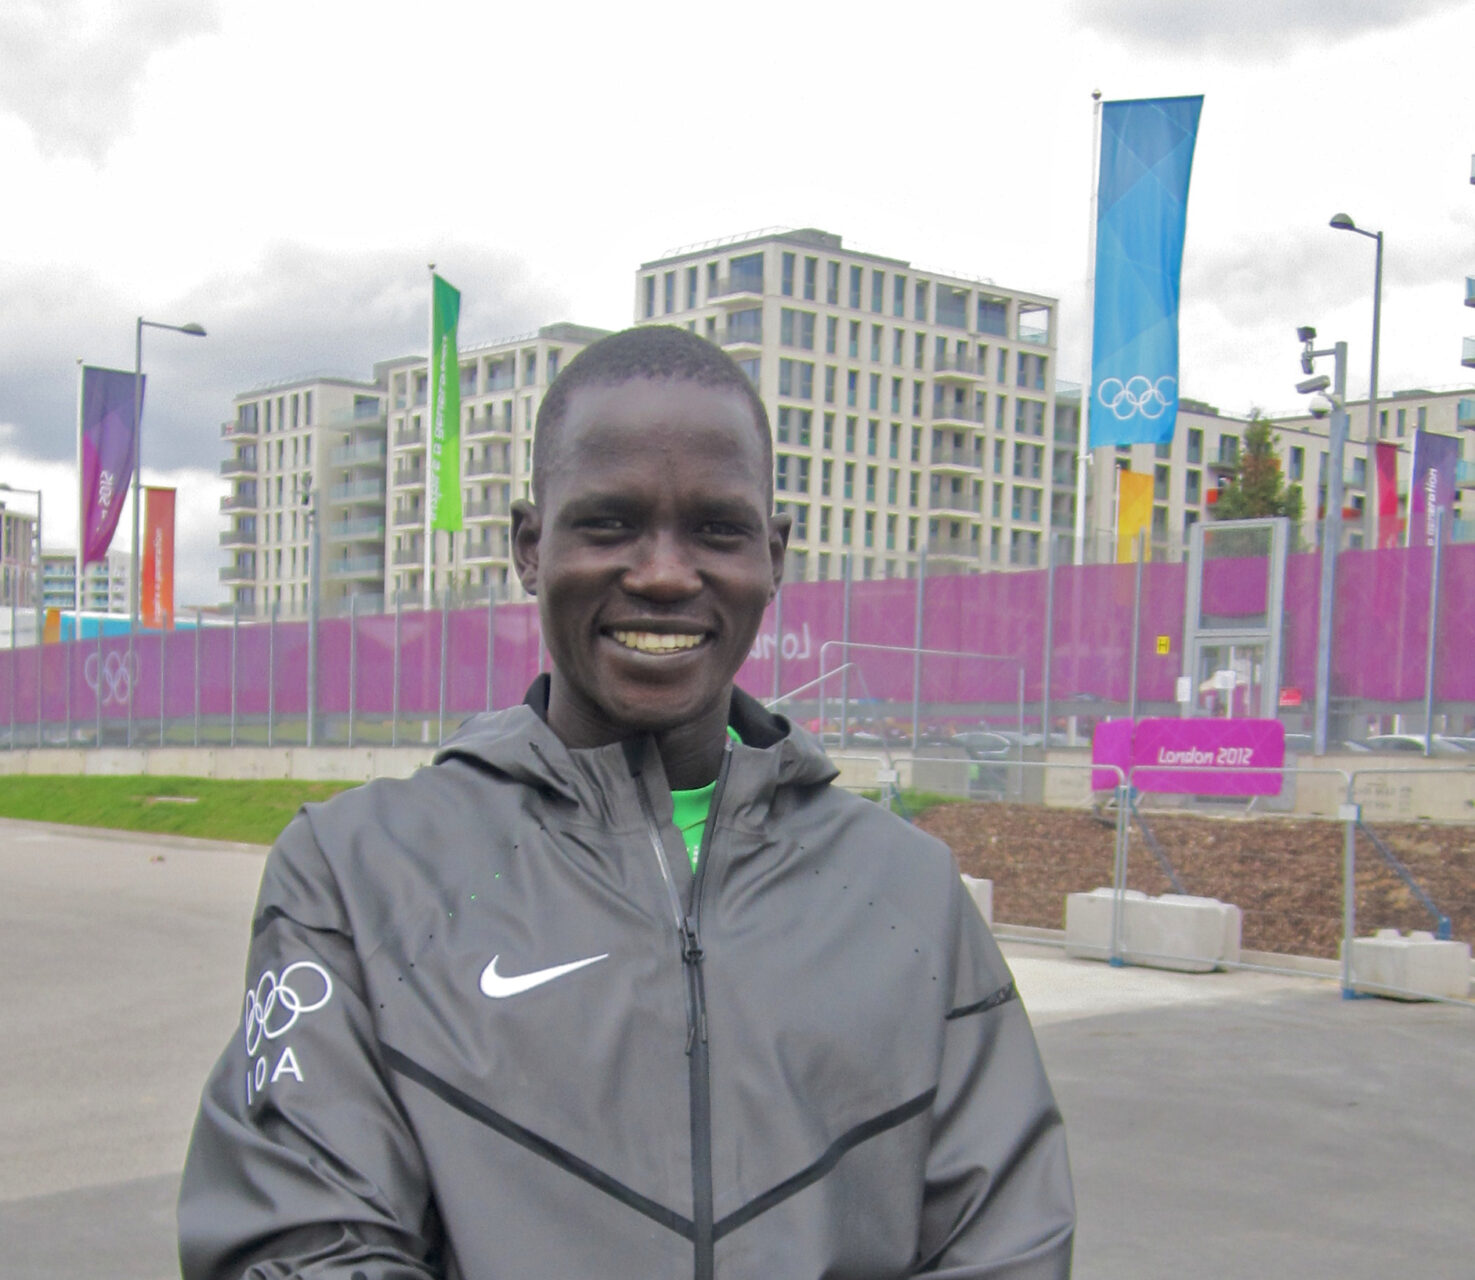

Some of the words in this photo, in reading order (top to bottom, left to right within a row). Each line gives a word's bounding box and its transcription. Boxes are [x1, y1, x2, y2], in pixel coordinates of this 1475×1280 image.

[98, 470, 114, 507] 2012
[1158, 746, 1214, 764] London
[1216, 747, 1254, 765] 2012
[246, 1046, 305, 1106] IOA
